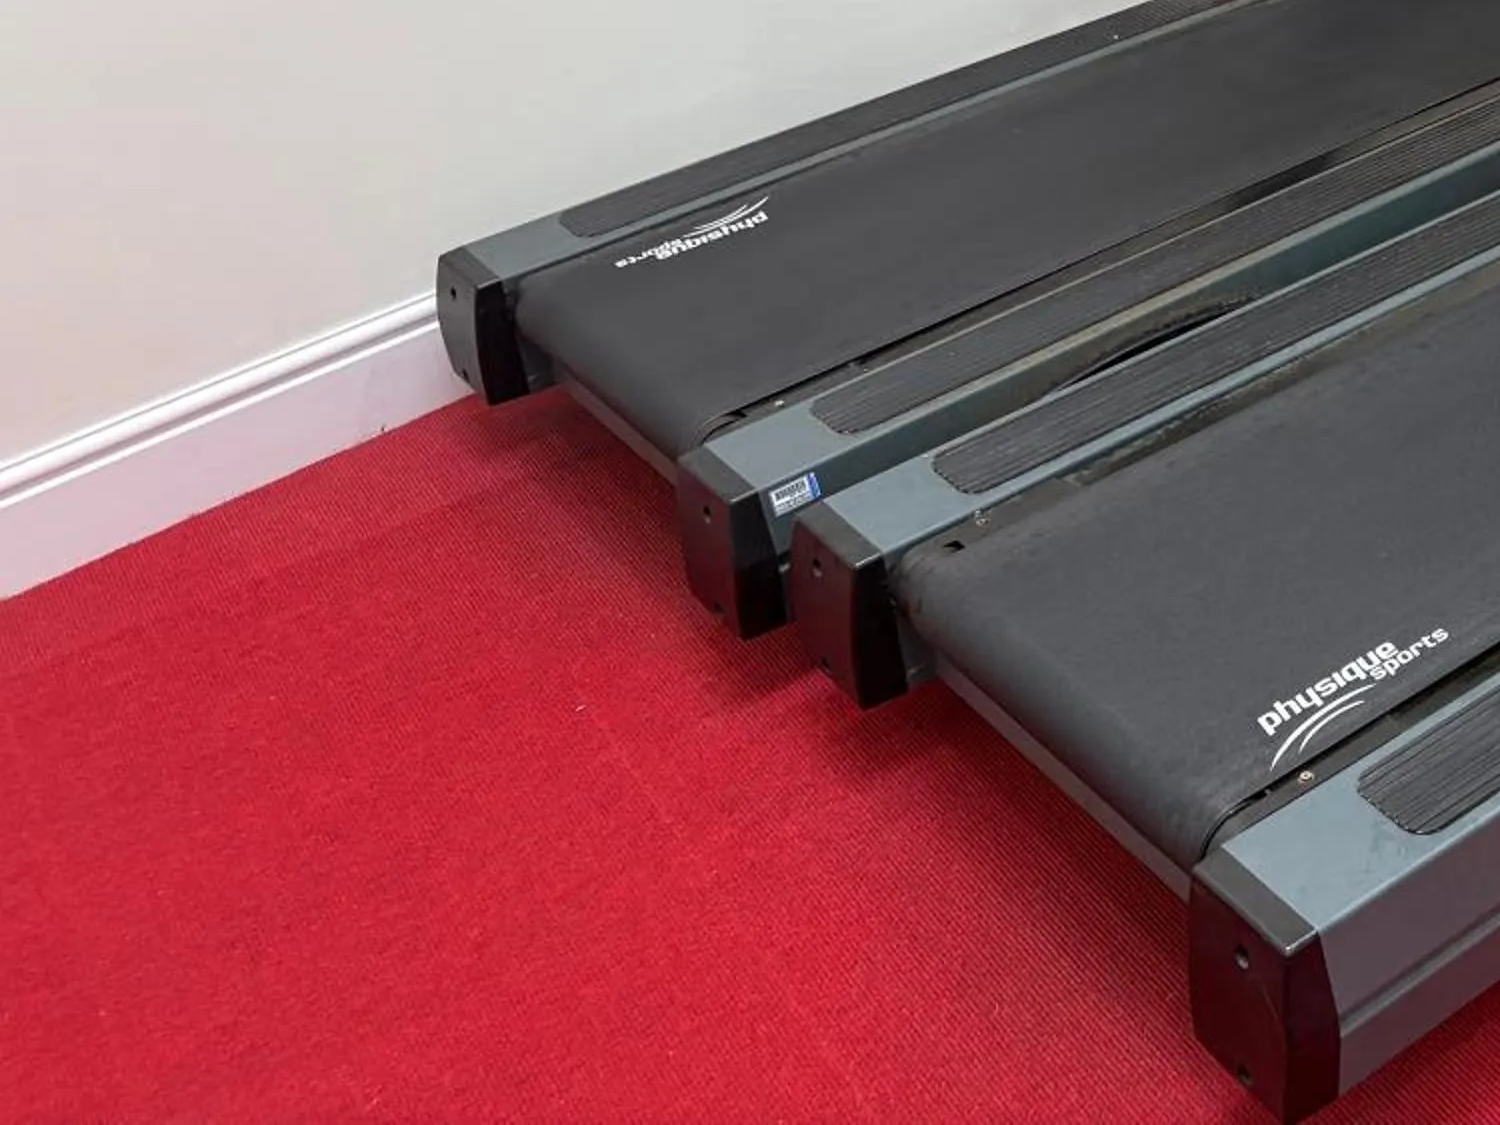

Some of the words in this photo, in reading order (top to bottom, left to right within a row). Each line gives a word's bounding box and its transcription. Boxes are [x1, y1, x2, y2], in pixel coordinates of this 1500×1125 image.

[655, 210, 769, 260] physique
[1369, 628, 1449, 681] sports
[1257, 641, 1399, 737] physique
